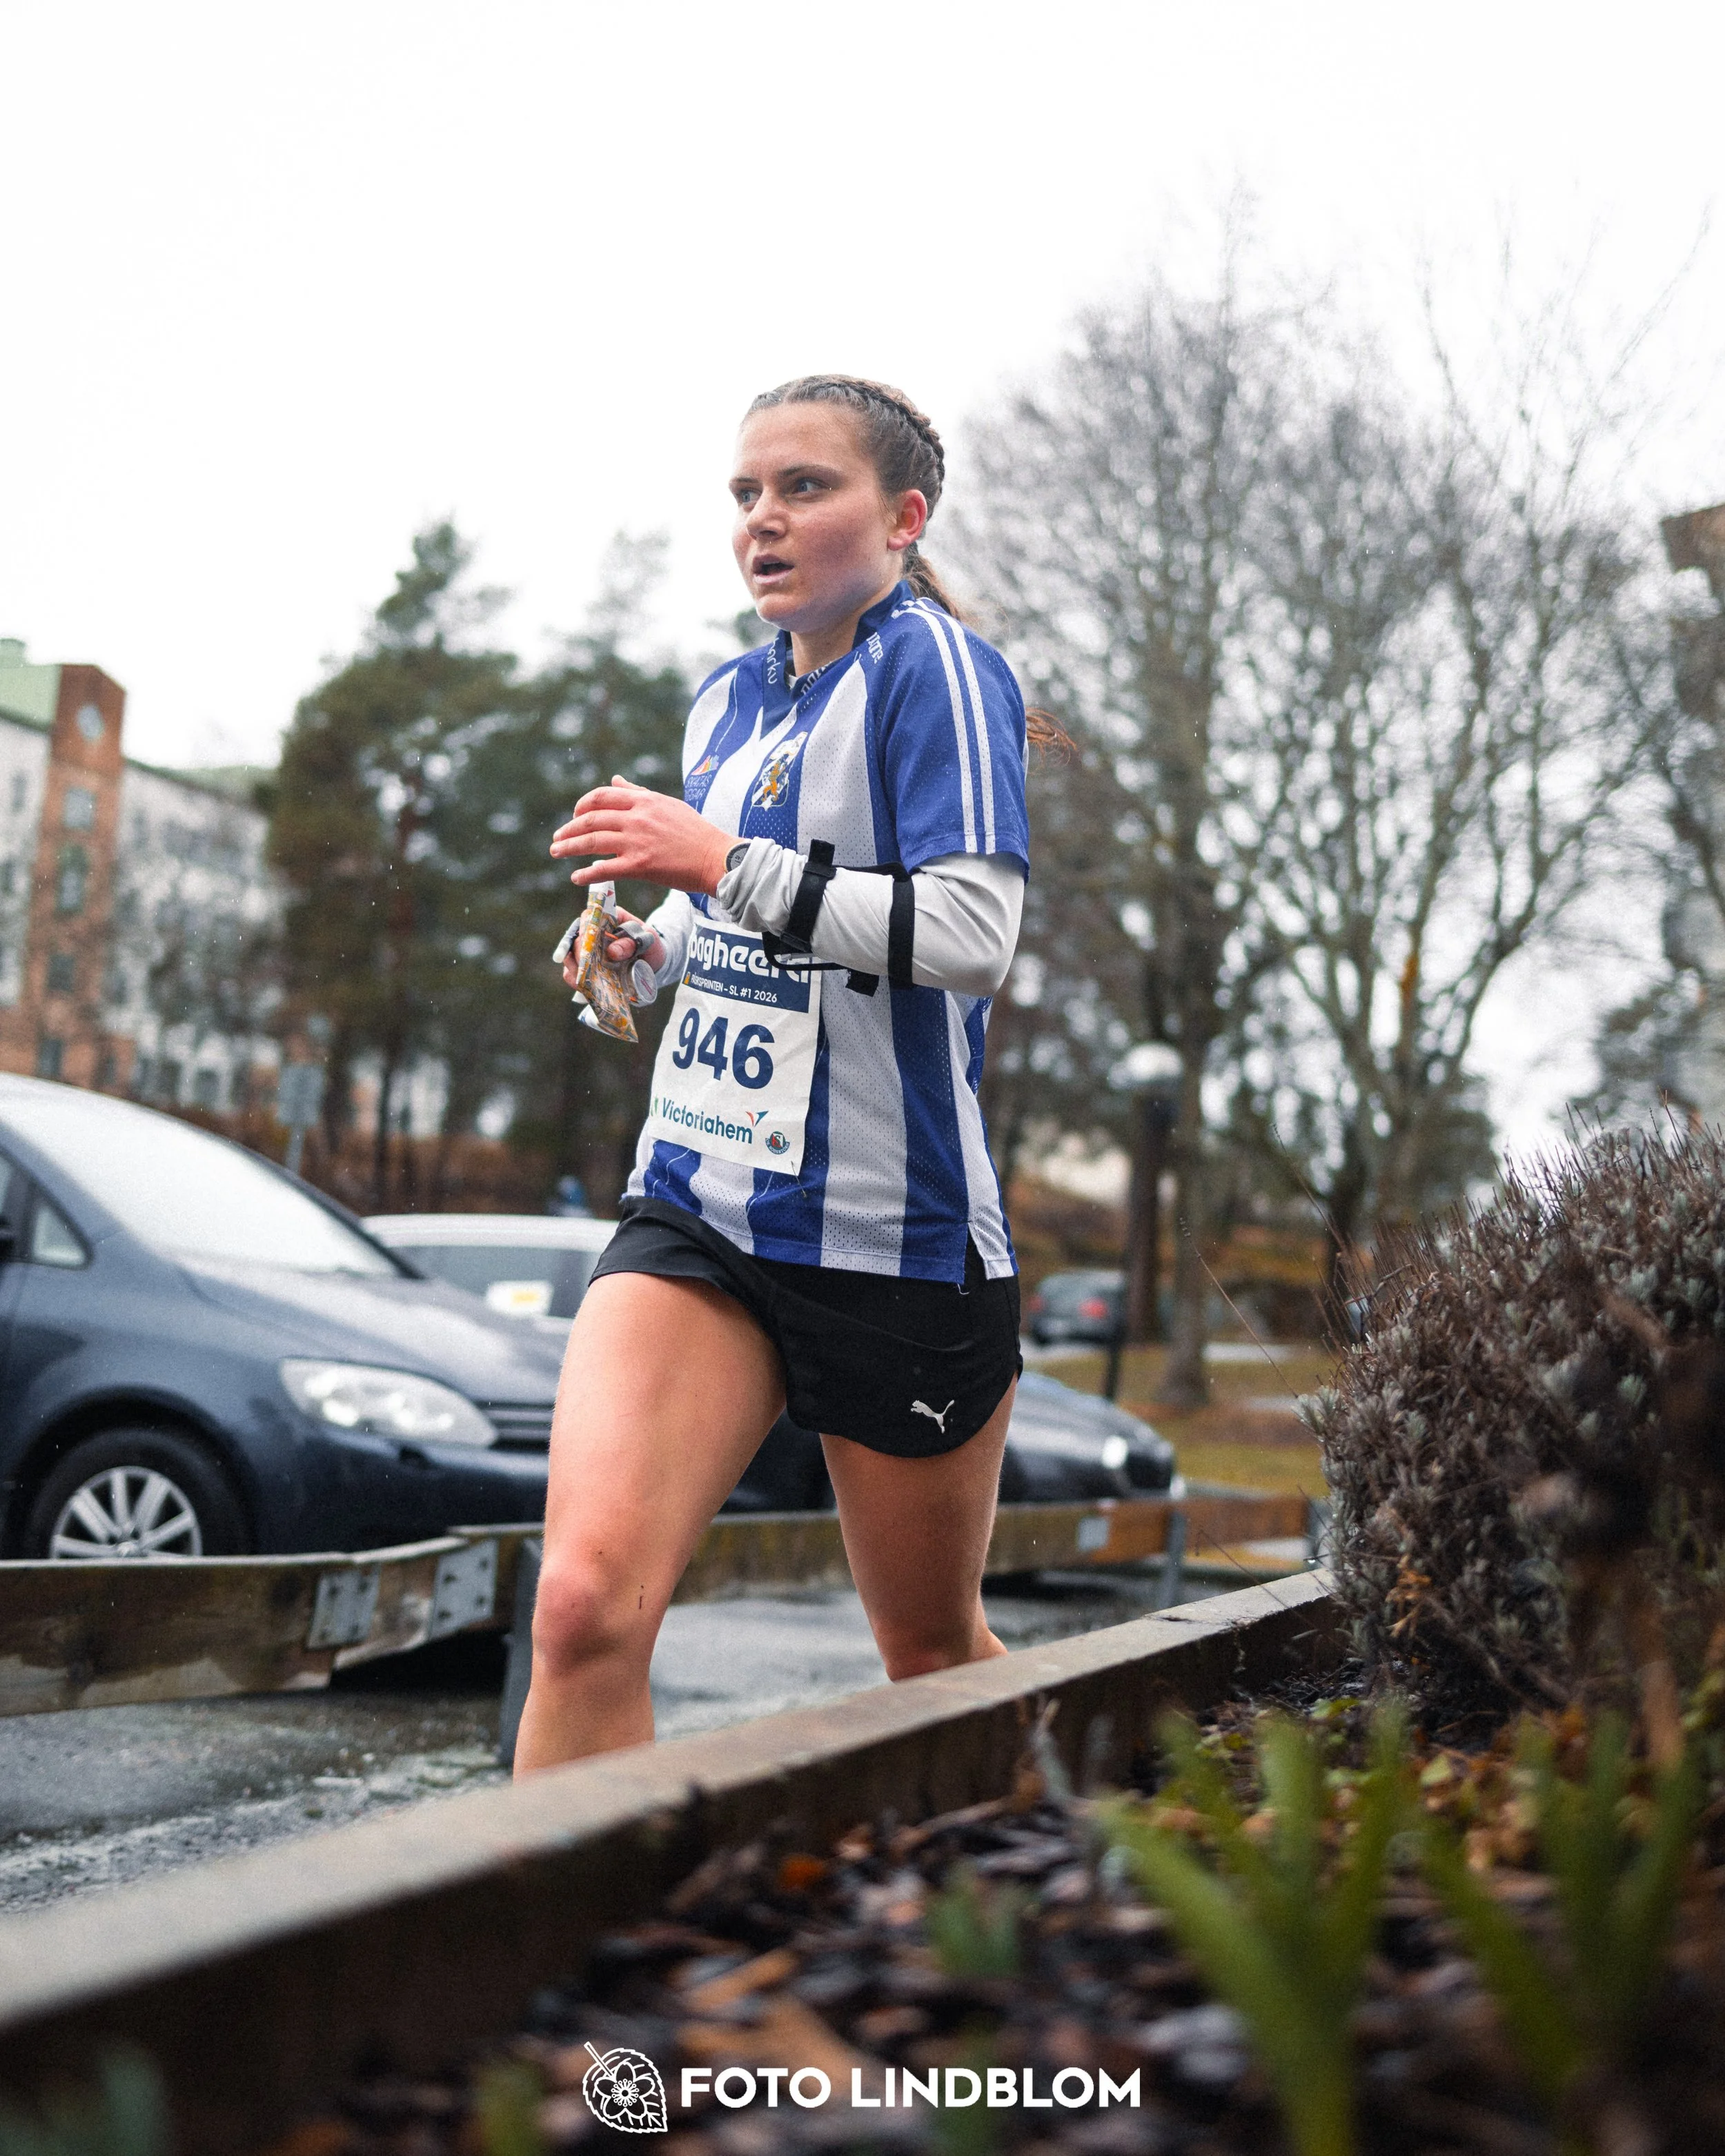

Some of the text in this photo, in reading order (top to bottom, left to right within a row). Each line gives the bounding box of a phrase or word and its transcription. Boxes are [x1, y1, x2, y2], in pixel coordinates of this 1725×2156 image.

[729, 985, 739, 996] SL
[740, 987, 751, 998] #1
[753, 990, 778, 1003] 2026
[672, 1007, 775, 1089] 946
[662, 1097, 753, 1145] Victoriahem
